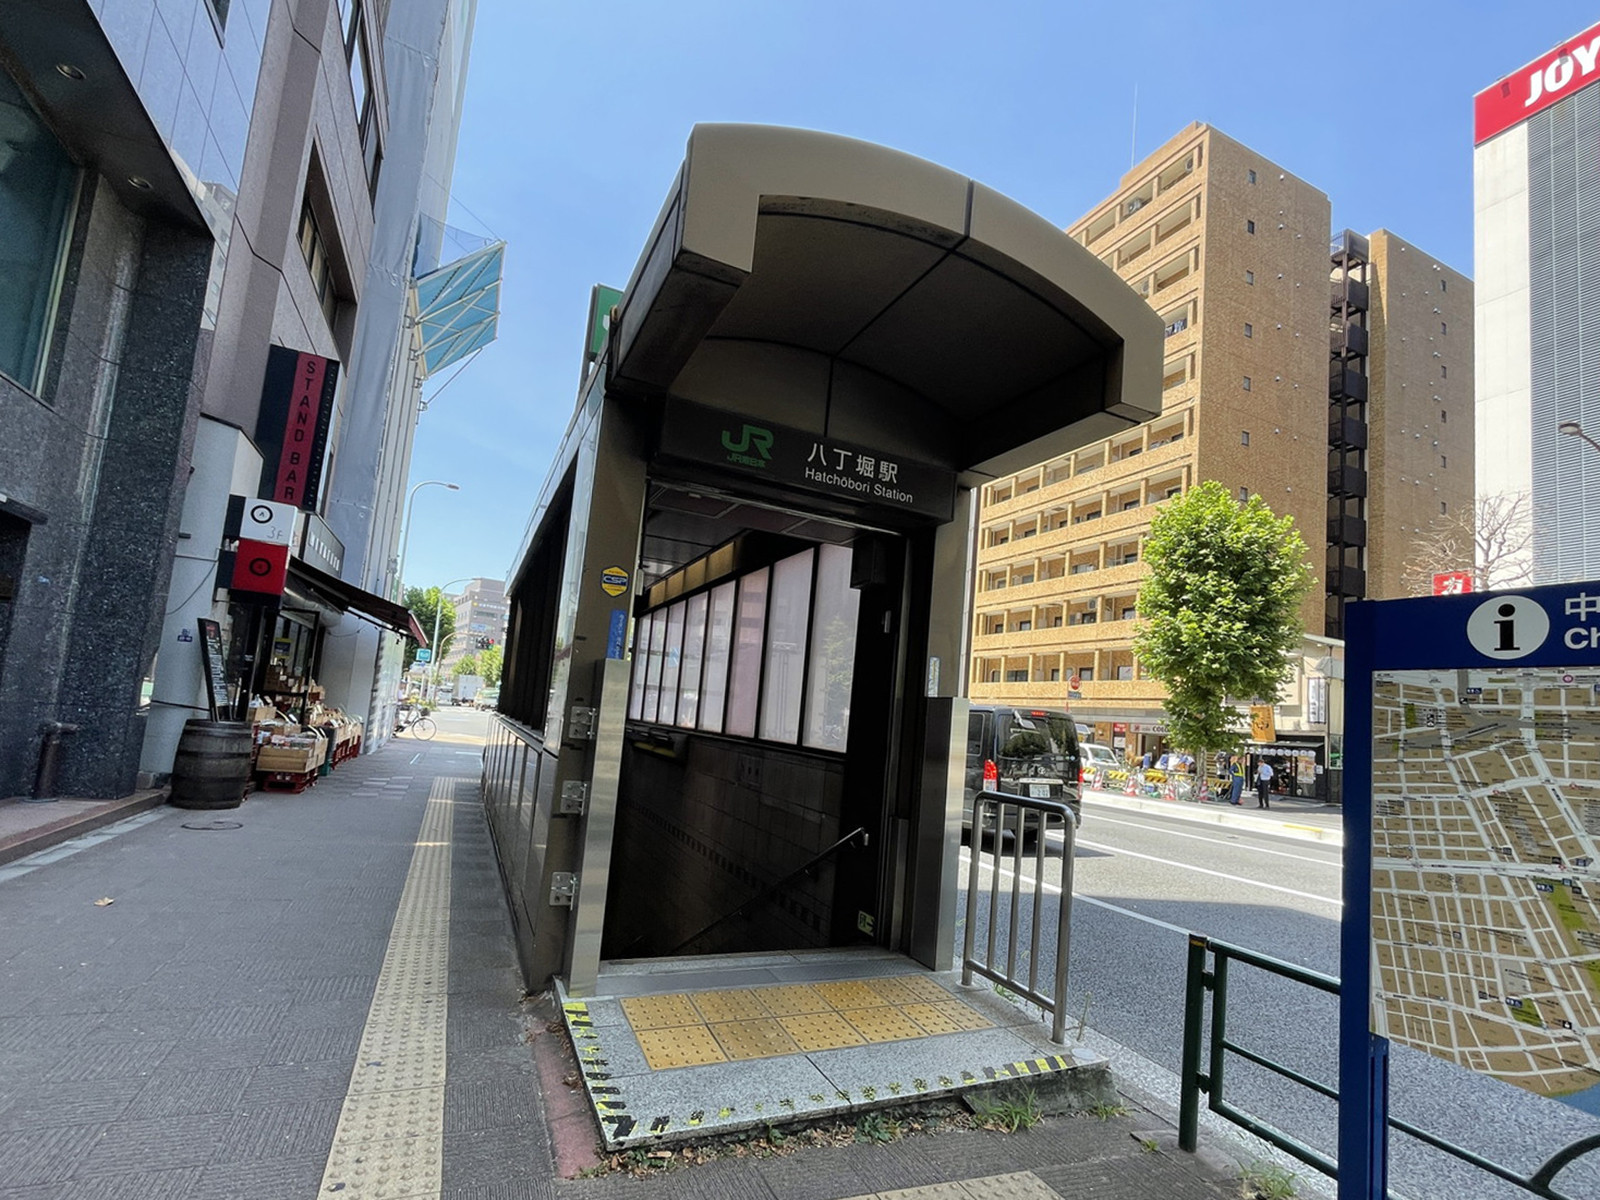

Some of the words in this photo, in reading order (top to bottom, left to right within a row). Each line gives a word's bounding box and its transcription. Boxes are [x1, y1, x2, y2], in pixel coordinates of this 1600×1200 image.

[294, 361, 316, 442] STAND
[721, 424, 774, 460] JR
[284, 452, 301, 500] BAR
[807, 443, 898, 484] 八丁堀駅
[805, 467, 871, 493] Hatchōbori
[873, 484, 914, 504] Station
[266, 525, 284, 540] 3F
[603, 575, 627, 584] CSP
[1565, 592, 1600, 622] 中
